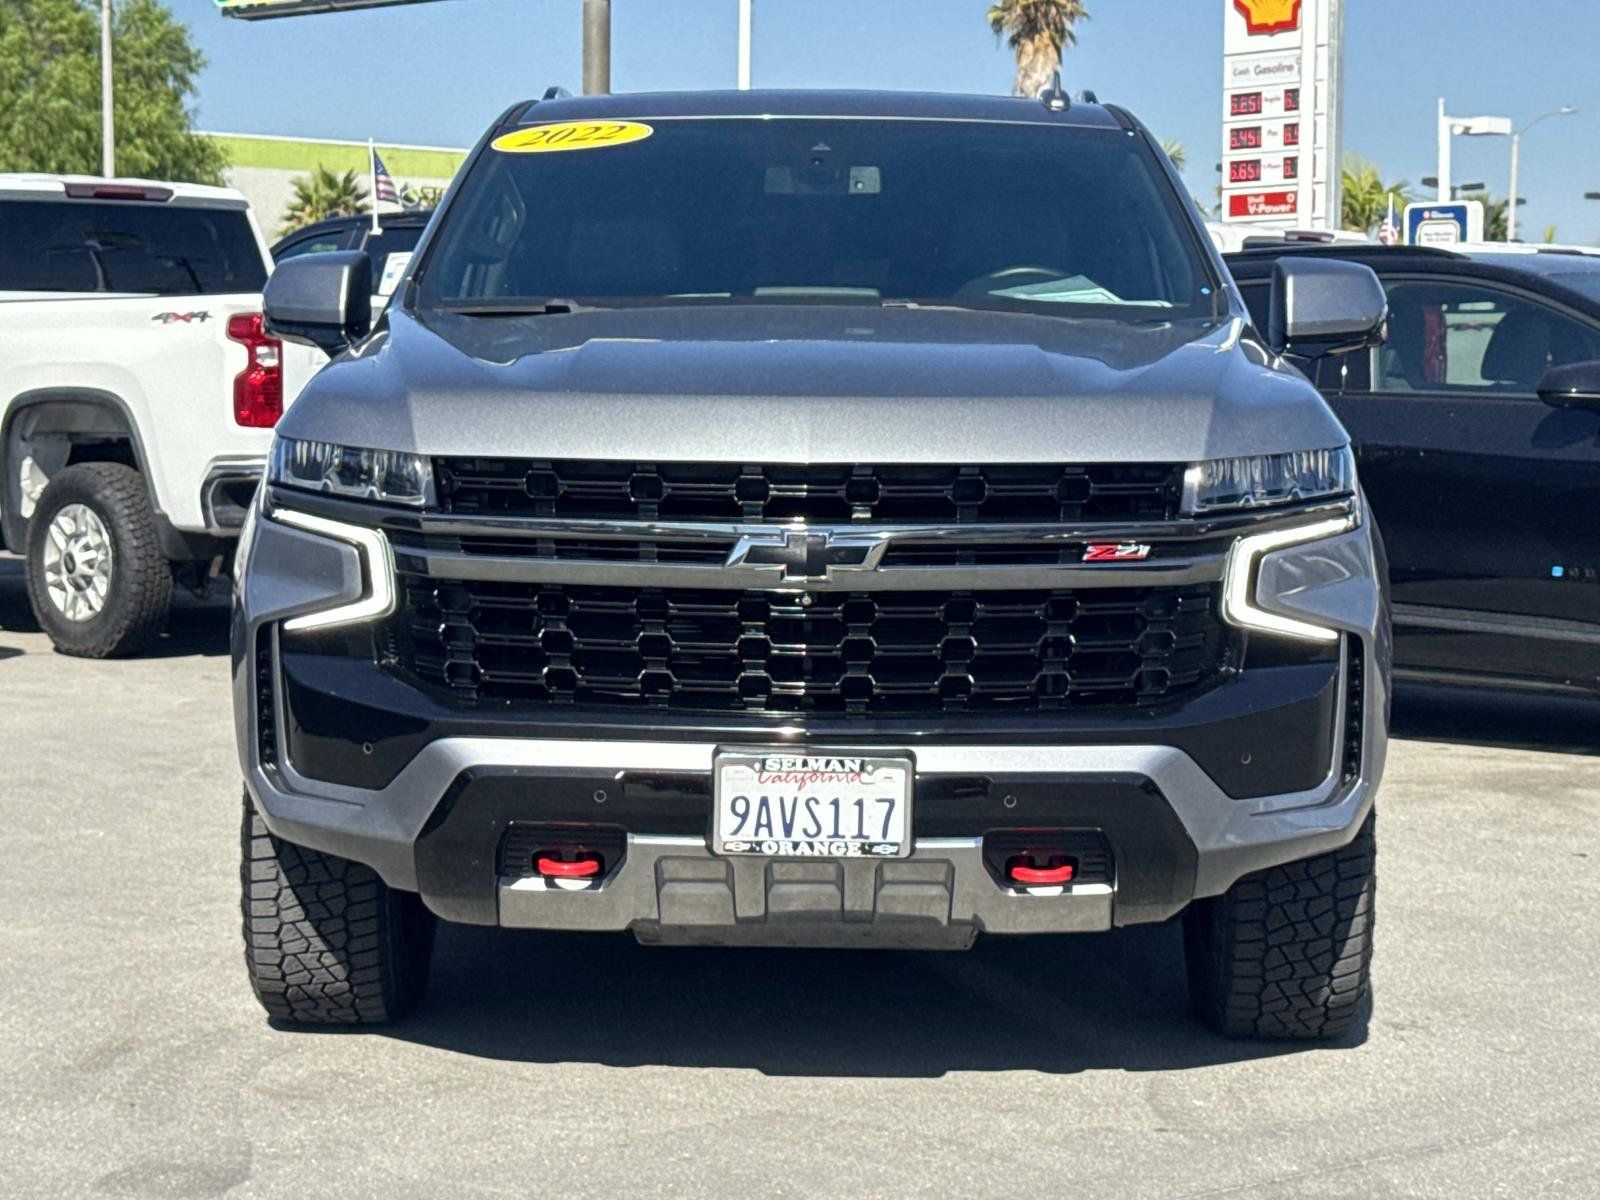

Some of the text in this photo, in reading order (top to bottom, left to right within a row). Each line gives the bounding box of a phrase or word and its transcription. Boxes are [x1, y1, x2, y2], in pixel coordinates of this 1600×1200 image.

[1254, 62, 1294, 76] Gasoline
[515, 125, 628, 147] 2022
[1247, 203, 1293, 214] V-Power
[1083, 544, 1151, 560] Z71
[765, 758, 862, 772] SELMAN
[757, 771, 875, 791] California
[730, 795, 896, 840] 9AVS117
[761, 841, 863, 855] ORANGE
